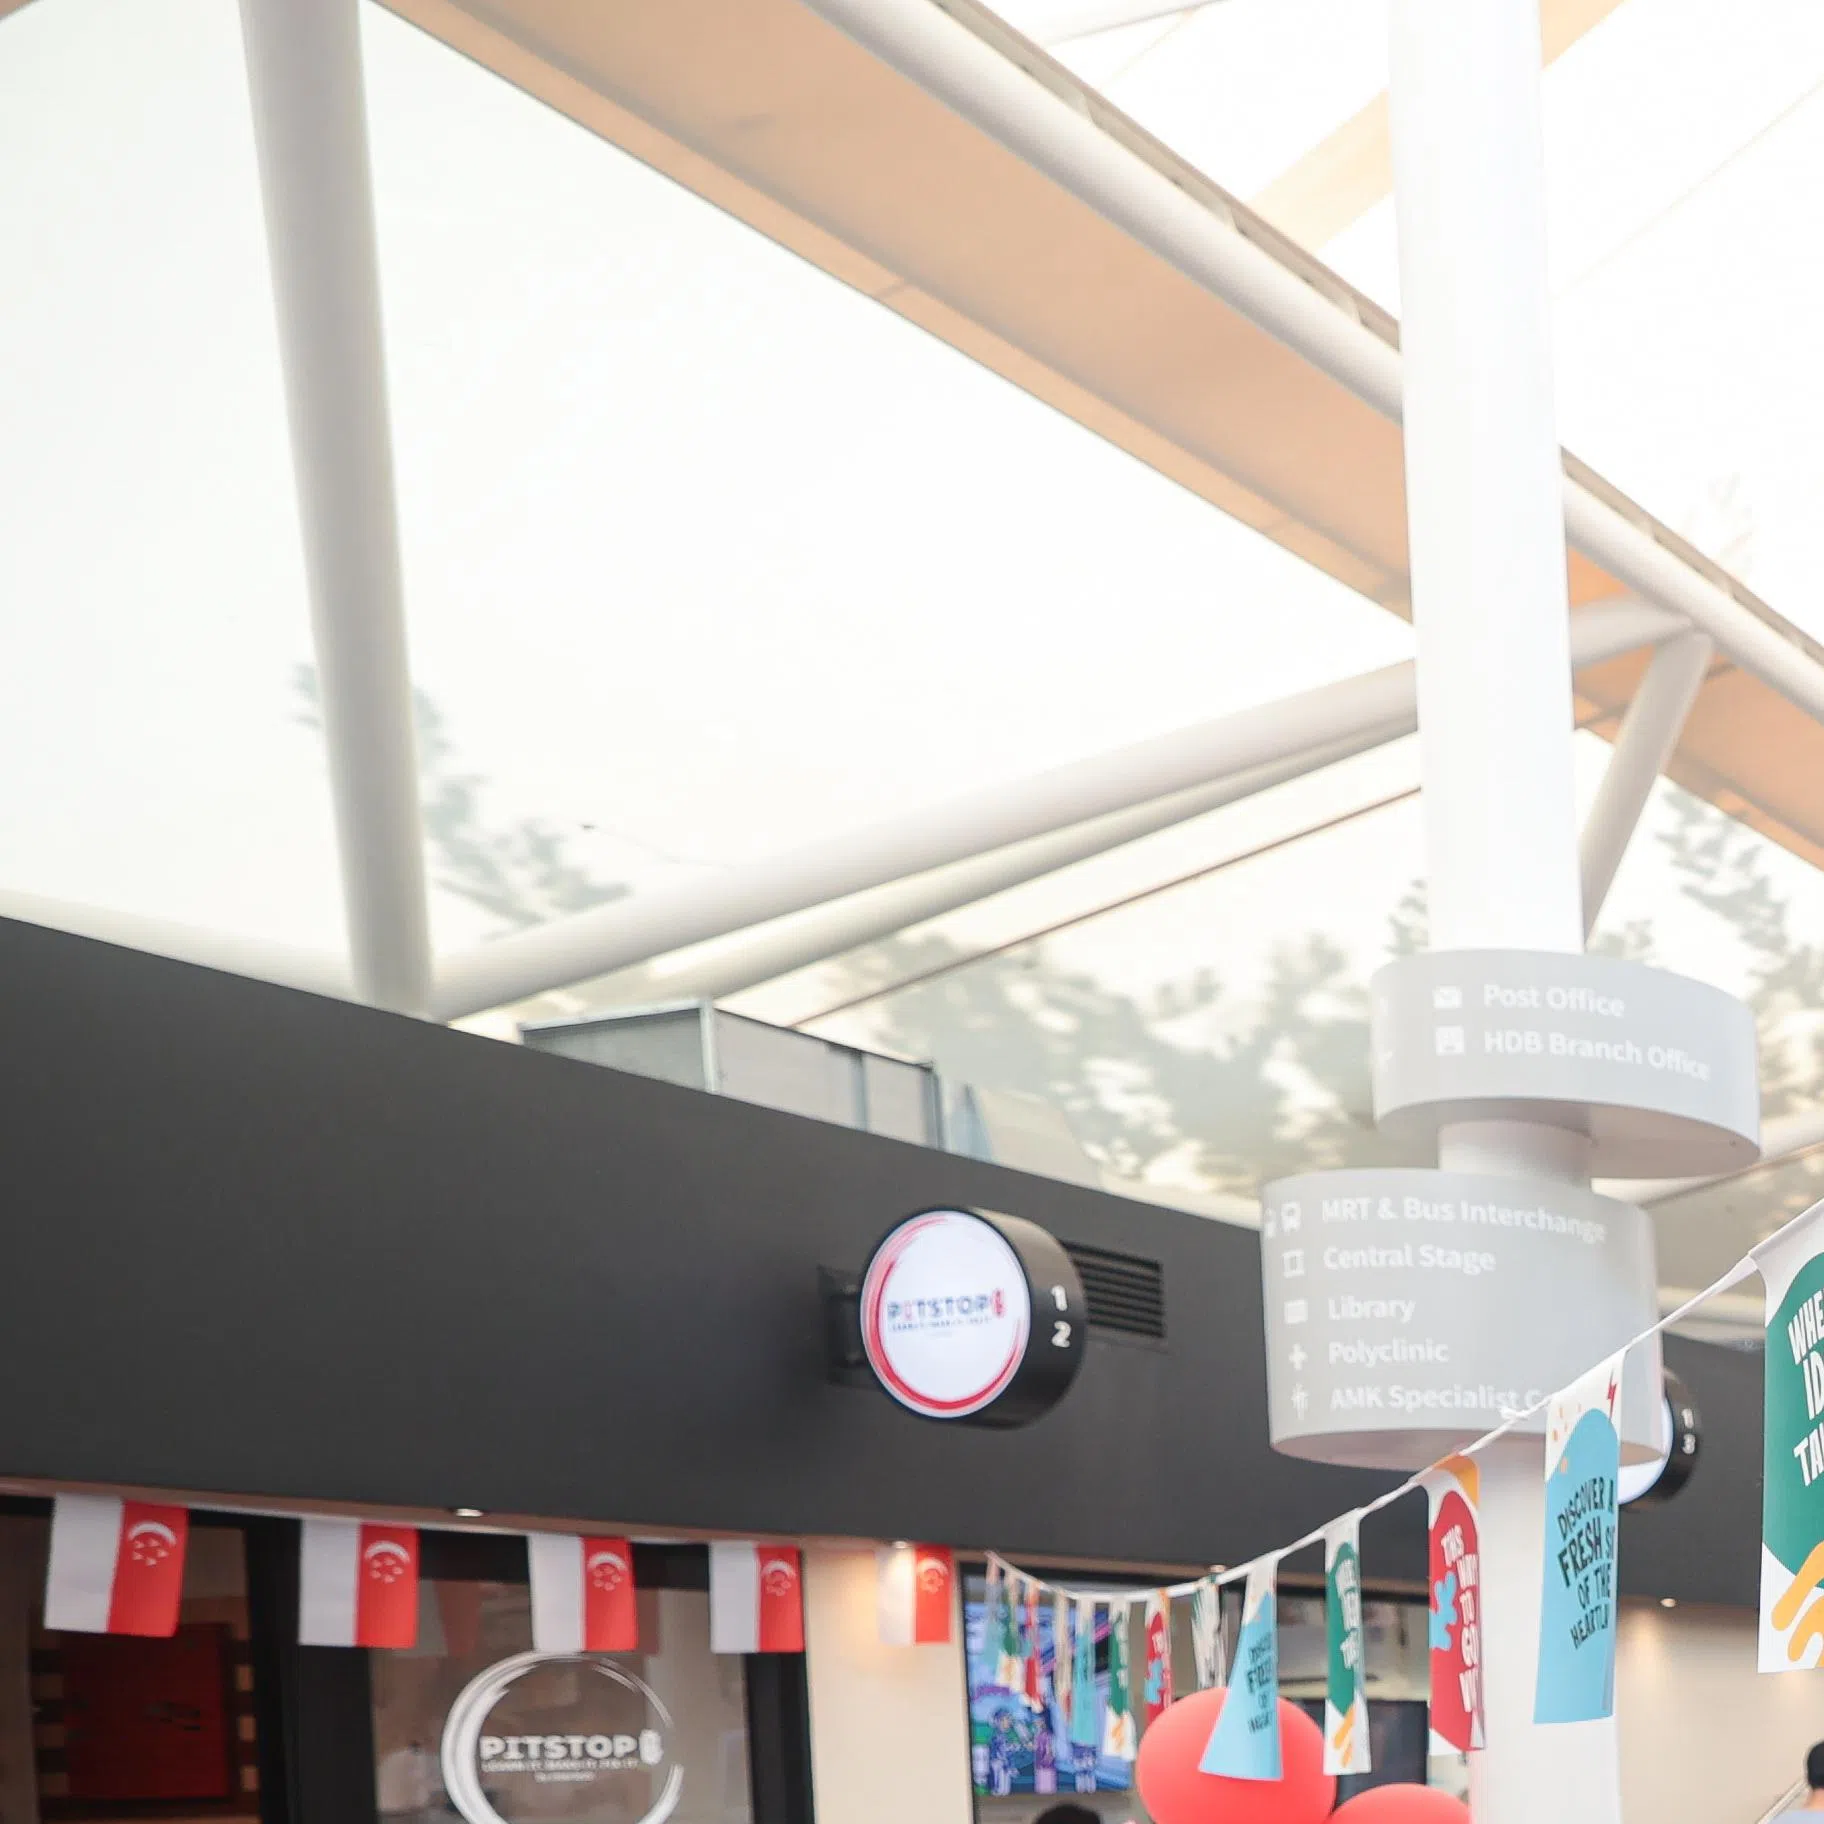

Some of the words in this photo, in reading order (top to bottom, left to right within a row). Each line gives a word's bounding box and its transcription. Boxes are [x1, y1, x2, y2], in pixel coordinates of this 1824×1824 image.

[1483, 984, 1540, 1009] Post
[1547, 986, 1626, 1018] Office
[1483, 1030, 1543, 1054] HDB
[1549, 1033, 1643, 1066] Branch
[1648, 1044, 1711, 1082] Office
[1321, 1199, 1373, 1222] MRT
[1376, 1198, 1398, 1220] &
[1403, 1197, 1455, 1221] Bus
[1461, 1199, 1608, 1244] Interchange
[1323, 1243, 1413, 1271] Central
[1419, 1244, 1496, 1276] Stage
[1328, 1297, 1415, 1323] Library
[1328, 1338, 1449, 1368] Polyclinic
[1329, 1386, 1382, 1410] AMK
[1557, 1477, 1605, 1540] DISCOVER
[1557, 1524, 1602, 1589] FRESH
[1577, 1575, 1591, 1610] OF
[1594, 1564, 1611, 1602] THE
[479, 1735, 638, 1760] PITSTOP
